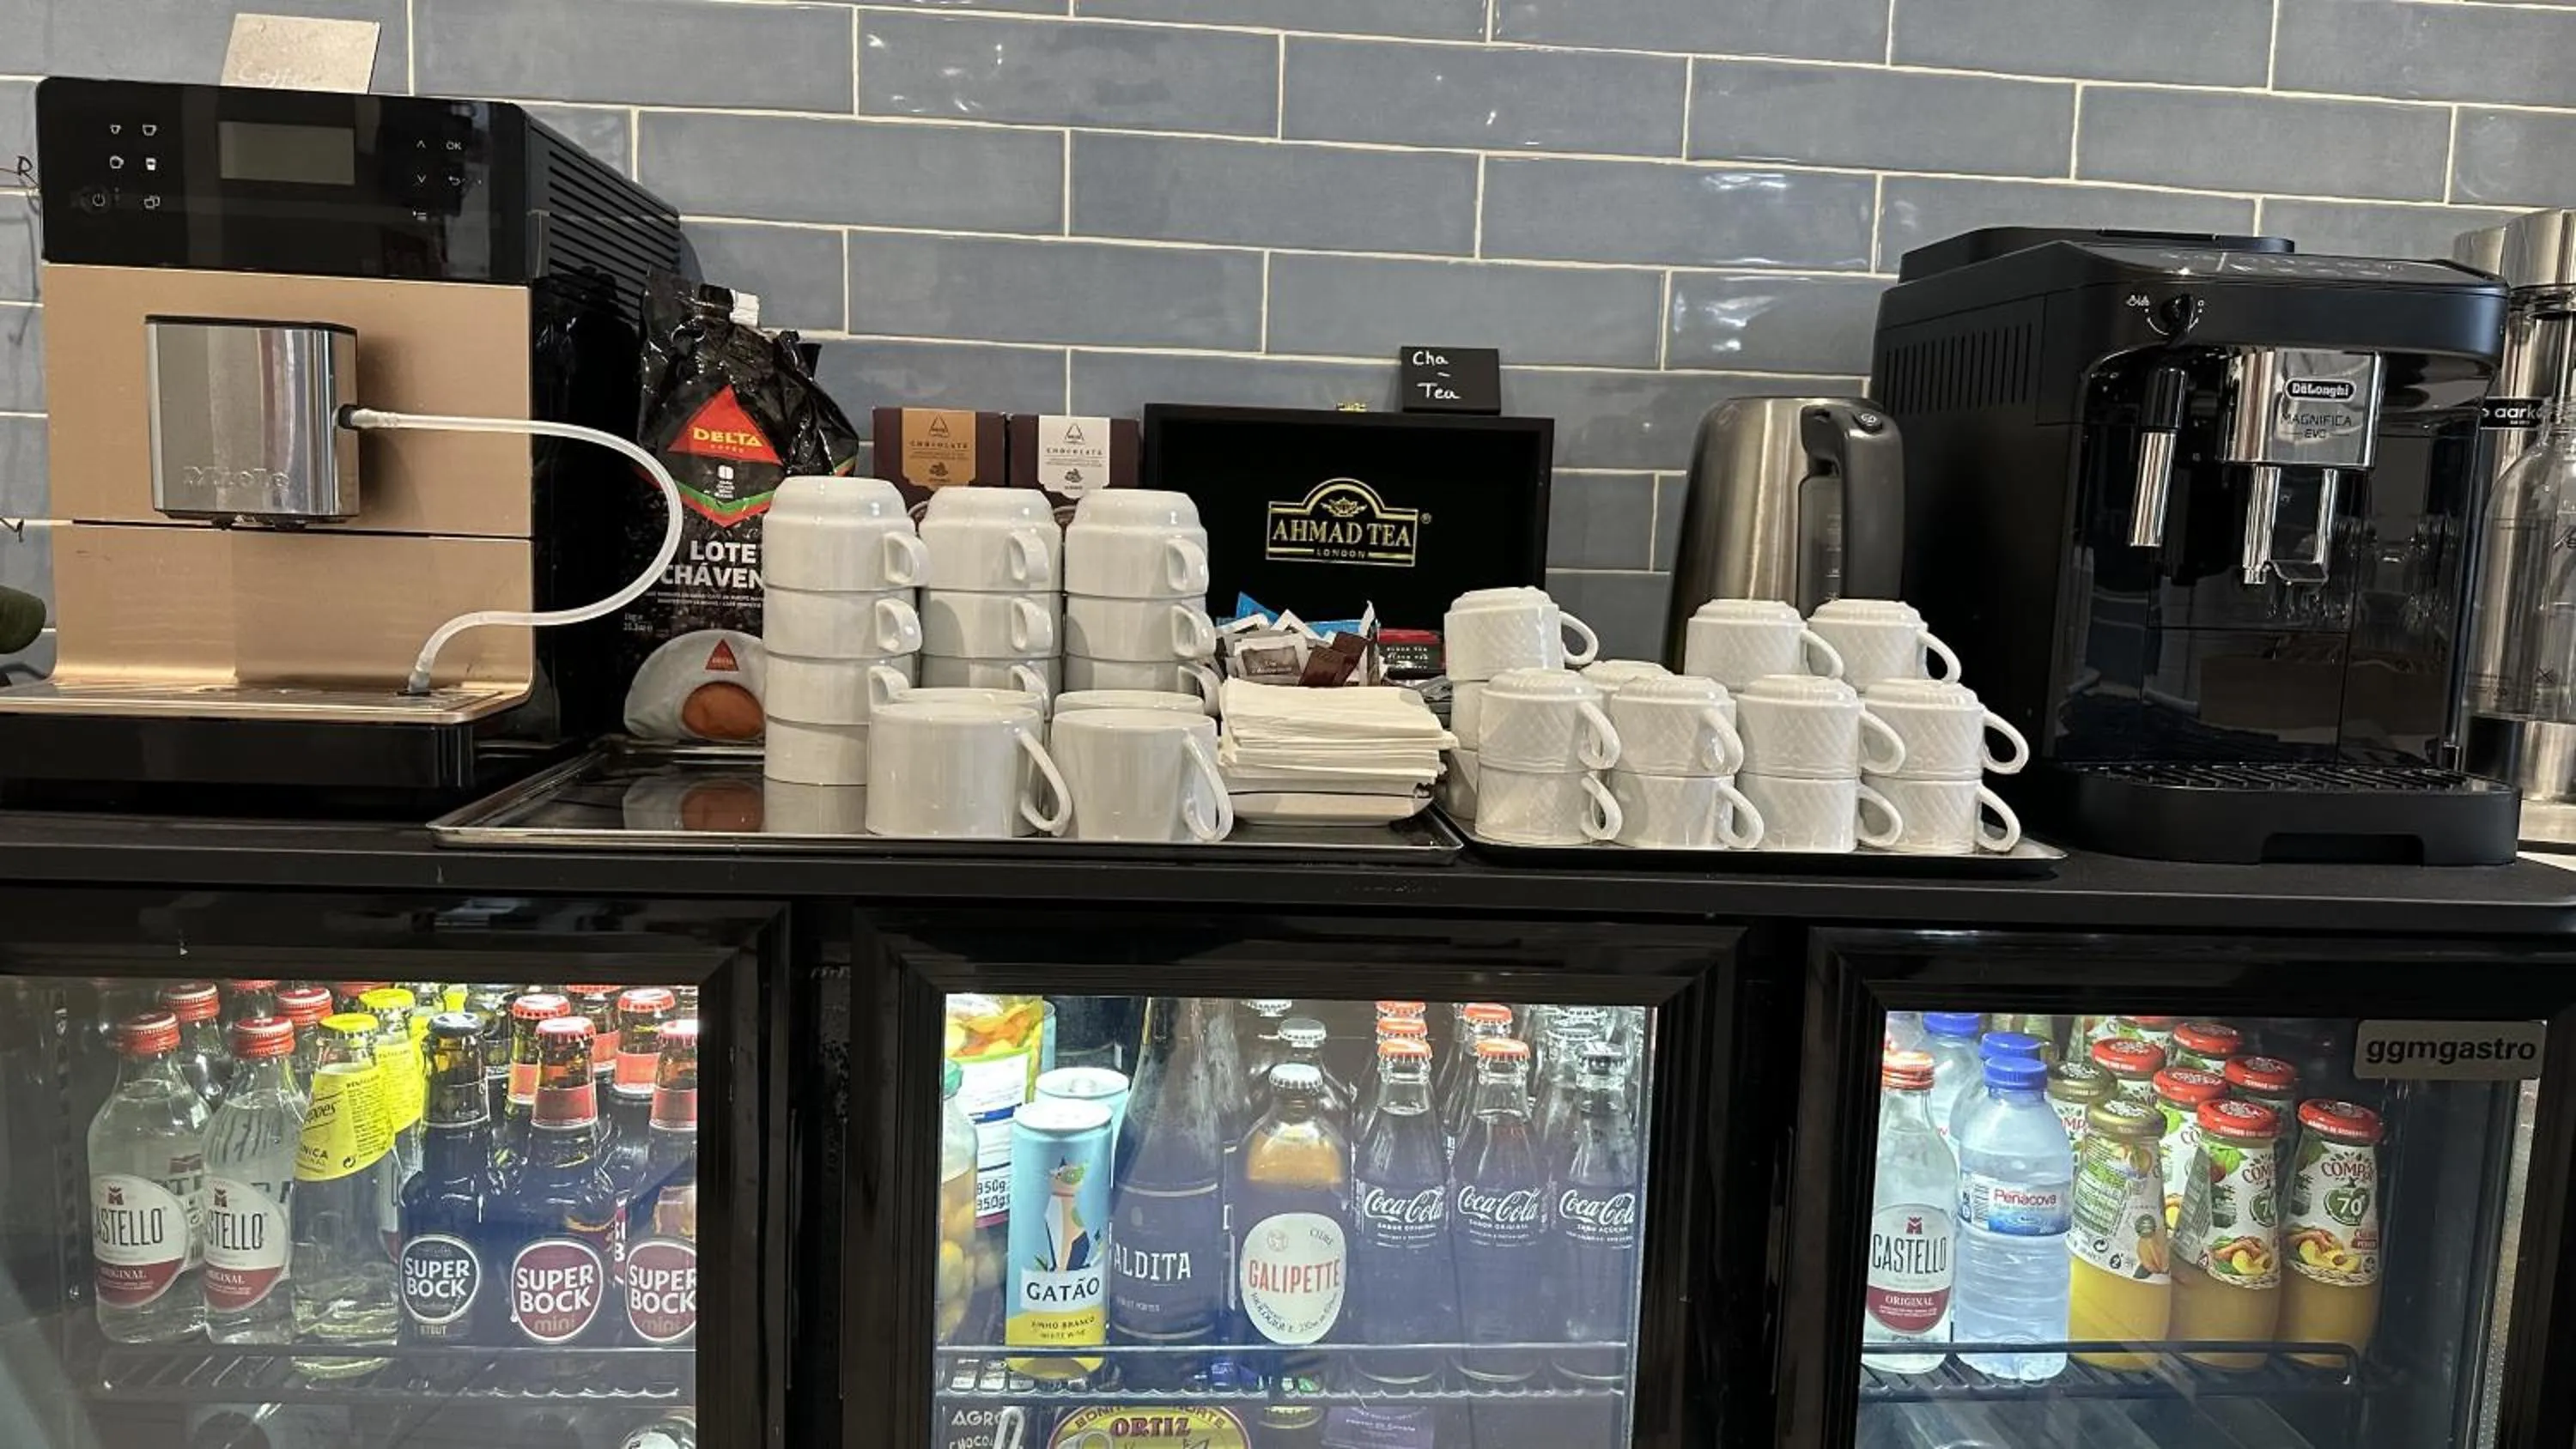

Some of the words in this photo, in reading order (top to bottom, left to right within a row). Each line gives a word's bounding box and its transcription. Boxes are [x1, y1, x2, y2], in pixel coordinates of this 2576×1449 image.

[446, 141, 462, 150] OK
[1417, 383, 1461, 399] Tea
[2281, 413, 2353, 427] MAGNIFICA
[692, 427, 762, 447] DELTA
[1272, 518, 1363, 544] AHMAD
[1366, 523, 1411, 547] TEA
[690, 540, 756, 564] LOTE
[1315, 548, 1365, 560] LONDON
[659, 561, 764, 590] CHÁVEN
[2366, 1037, 2537, 1065] ggmgastro
[2242, 1166, 2275, 1185] COM
[2321, 1161, 2375, 1183] COMPA
[1994, 1188, 2057, 1206] Penacova
[96, 1208, 165, 1246] ASTELLO
[209, 1211, 264, 1251] STELLO
[1114, 1243, 1192, 1282] ALDITA
[1872, 1234, 1947, 1274] CASTELLO
[404, 1258, 471, 1279] SUPER
[517, 1264, 595, 1291] SUPER
[1249, 1258, 1341, 1294] GALIPETTE
[406, 1276, 467, 1298] BOCK
[1026, 1276, 1101, 1302] GATÃO
[519, 1286, 592, 1314] BOCK
[630, 1288, 696, 1314] BOCK
[1885, 1294, 1935, 1306] ORIGINAL
[1109, 1417, 1192, 1438] ORTIZ
